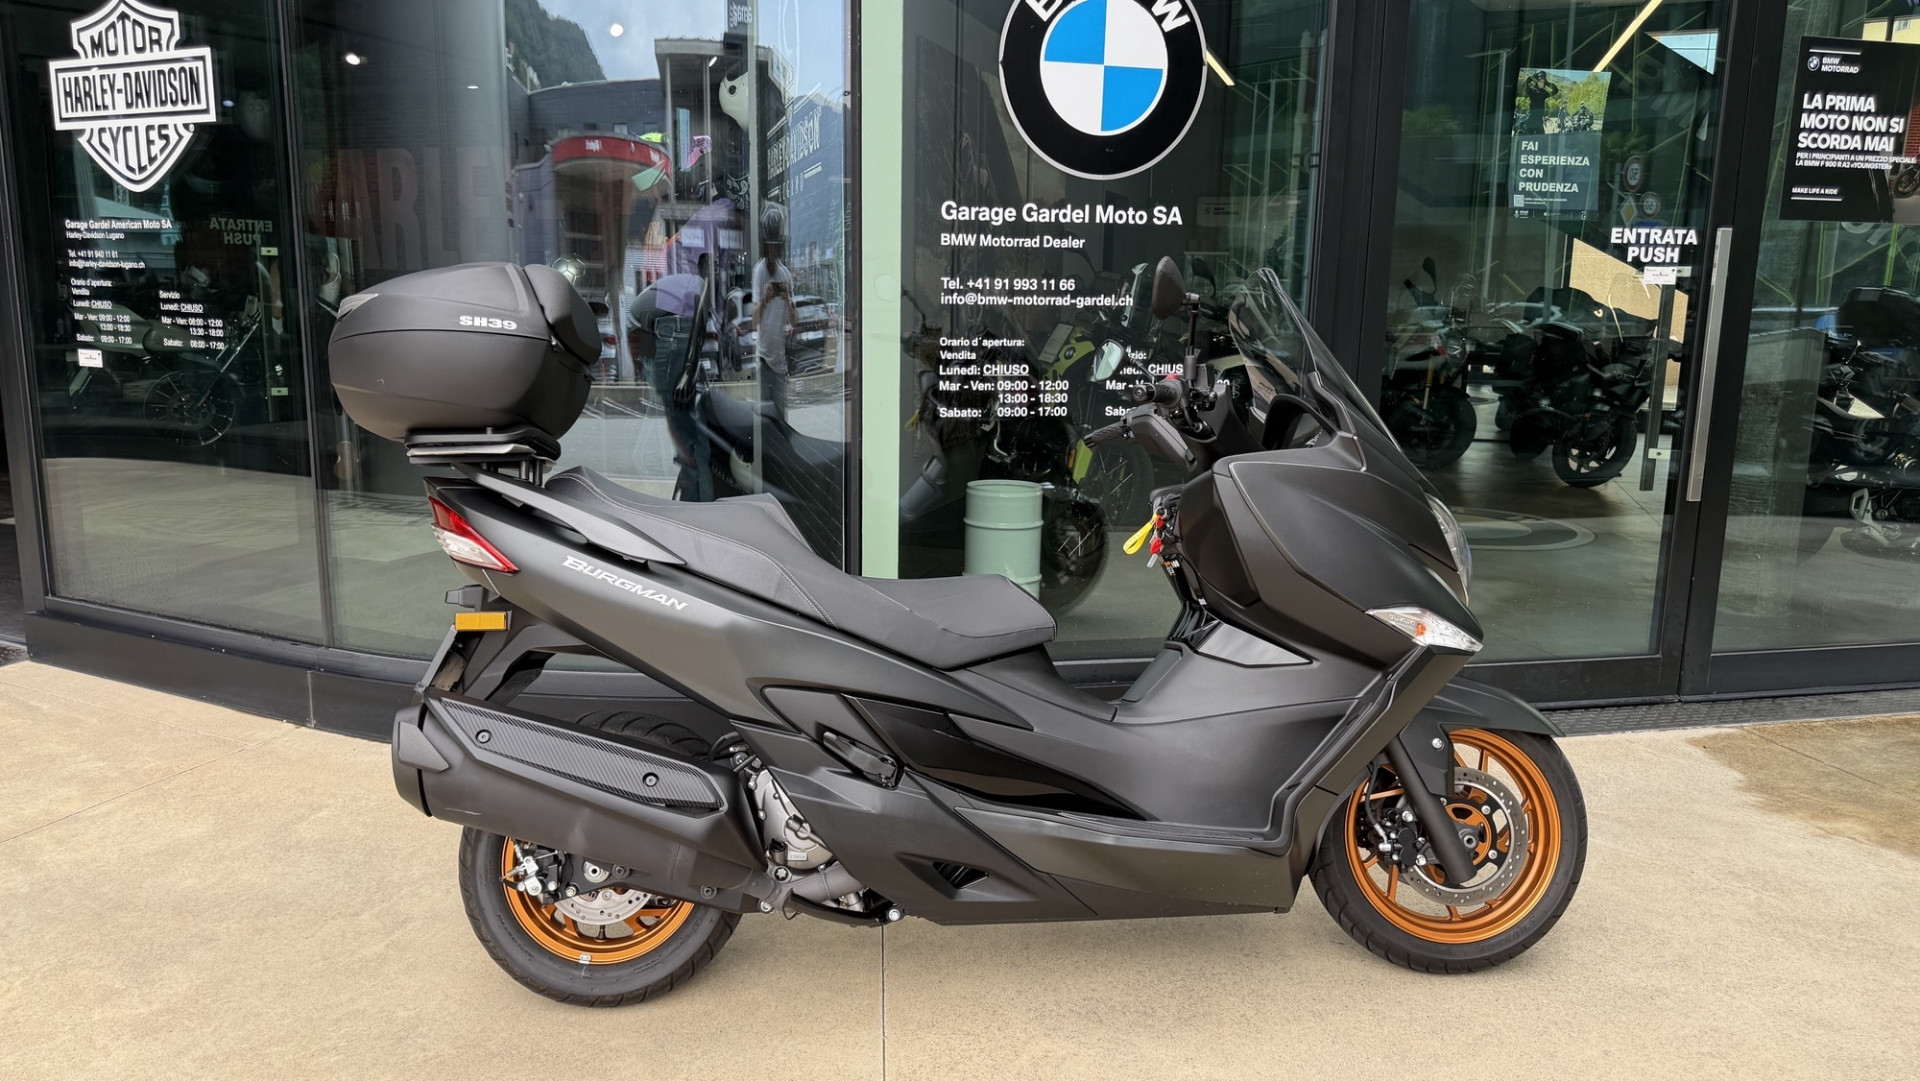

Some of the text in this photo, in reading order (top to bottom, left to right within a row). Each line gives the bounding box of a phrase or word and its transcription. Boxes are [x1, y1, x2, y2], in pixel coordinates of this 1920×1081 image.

[90, 11, 163, 58] MOTOR
[1821, 65, 1859, 73] MOTORRAD
[62, 66, 201, 113] HARLEY-DAVIDSON
[1803, 94, 1875, 112] LA PRIMA
[1800, 114, 1904, 133] MOTO NON SI
[1522, 141, 1538, 151] FAI
[1798, 132, 1894, 152] SCORDA MAI
[98, 124, 170, 175] CYCLES
[1520, 155, 1590, 166] ESPERIENZA
[1520, 169, 1543, 178] CON
[1519, 182, 1579, 192] PRUDENZA
[940, 200, 1183, 226] Garage Gardel Moto SA
[65, 219, 172, 231] Garage Gardel American Moto SA
[106, 231, 125, 240] Lugano
[940, 233, 1085, 248] BMW Motorrad Dealer
[1610, 228, 1698, 245] ENTRATA
[1627, 246, 1680, 262] PUSH
[71, 278, 86, 286] Orario
[941, 277, 1076, 290] Tel. +41 91 993 11 66
[159, 290, 180, 299] Servizio
[940, 292, 1133, 308] info@bmw-motorrad-gardel.ch
[91, 300, 112, 309] CHIUSO
[180, 303, 204, 313] CHIUSO
[162, 316, 172, 324] Mar
[208, 319, 223, 328] 12:00
[460, 315, 517, 330] SH39
[76, 334, 95, 342] Sabato:
[209, 328, 224, 337] 18:00
[164, 338, 183, 347] Sabato:
[209, 341, 224, 350] 17:00
[940, 337, 970, 346] Orario
[940, 350, 976, 360] Vendita
[983, 364, 1029, 376] CHIUSO
[1148, 364, 1184, 375] CHIUS
[939, 381, 961, 391] Mar
[970, 381, 995, 391] Ven:
[997, 380, 1028, 390] 09:00
[1039, 380, 1069, 390] 12:00
[1106, 380, 1126, 390] Mar
[998, 393, 1028, 403] 13:00
[1038, 393, 1068, 403] 18:30
[939, 407, 982, 417] Sabato:
[997, 407, 1028, 417] 09:00
[1038, 407, 1067, 417] 17:00
[562, 555, 688, 611] BURGMAN
